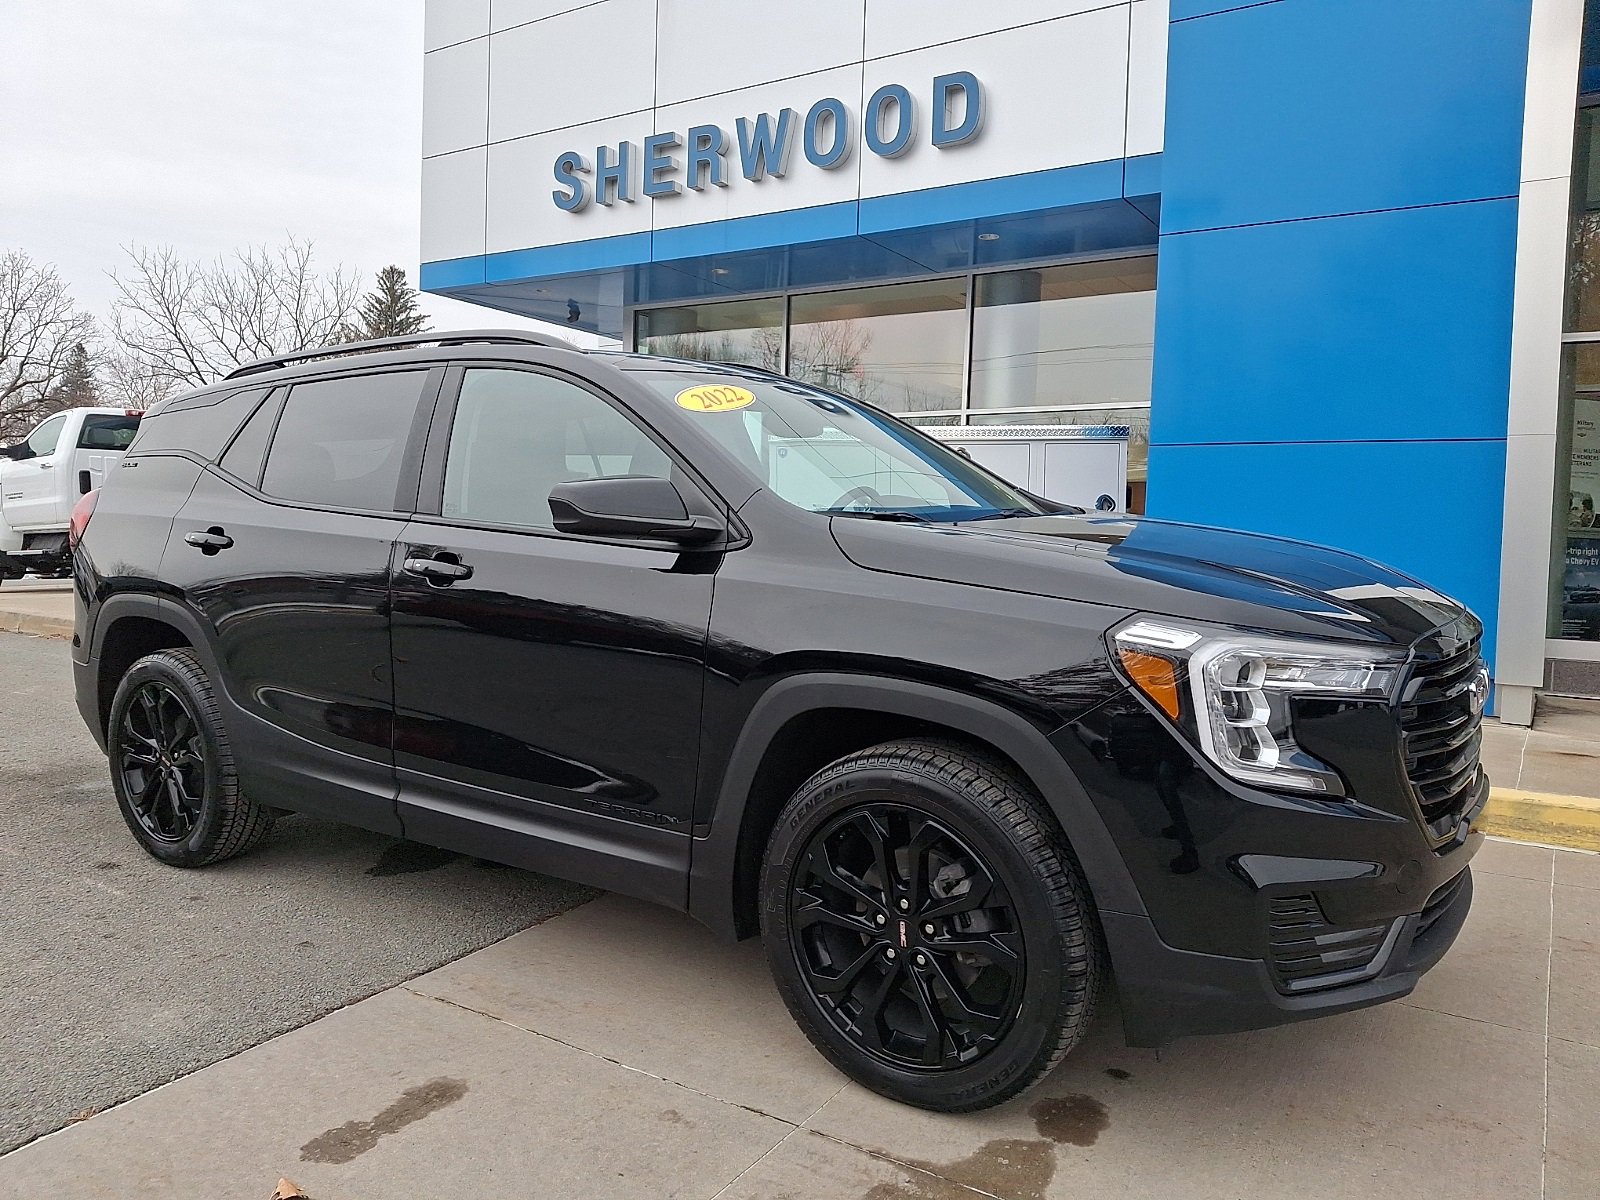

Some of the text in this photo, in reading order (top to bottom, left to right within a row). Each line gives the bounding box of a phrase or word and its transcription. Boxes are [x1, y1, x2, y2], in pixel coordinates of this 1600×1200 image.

[552, 71, 987, 214] SHERWOOD
[690, 386, 745, 409] 2022
[1570, 557, 1591, 567] Chevy
[1590, 557, 1600, 566] EV
[1582, 546, 1599, 557] right
[583, 797, 680, 826] TERRAIN
[790, 781, 855, 831] GENERAL
